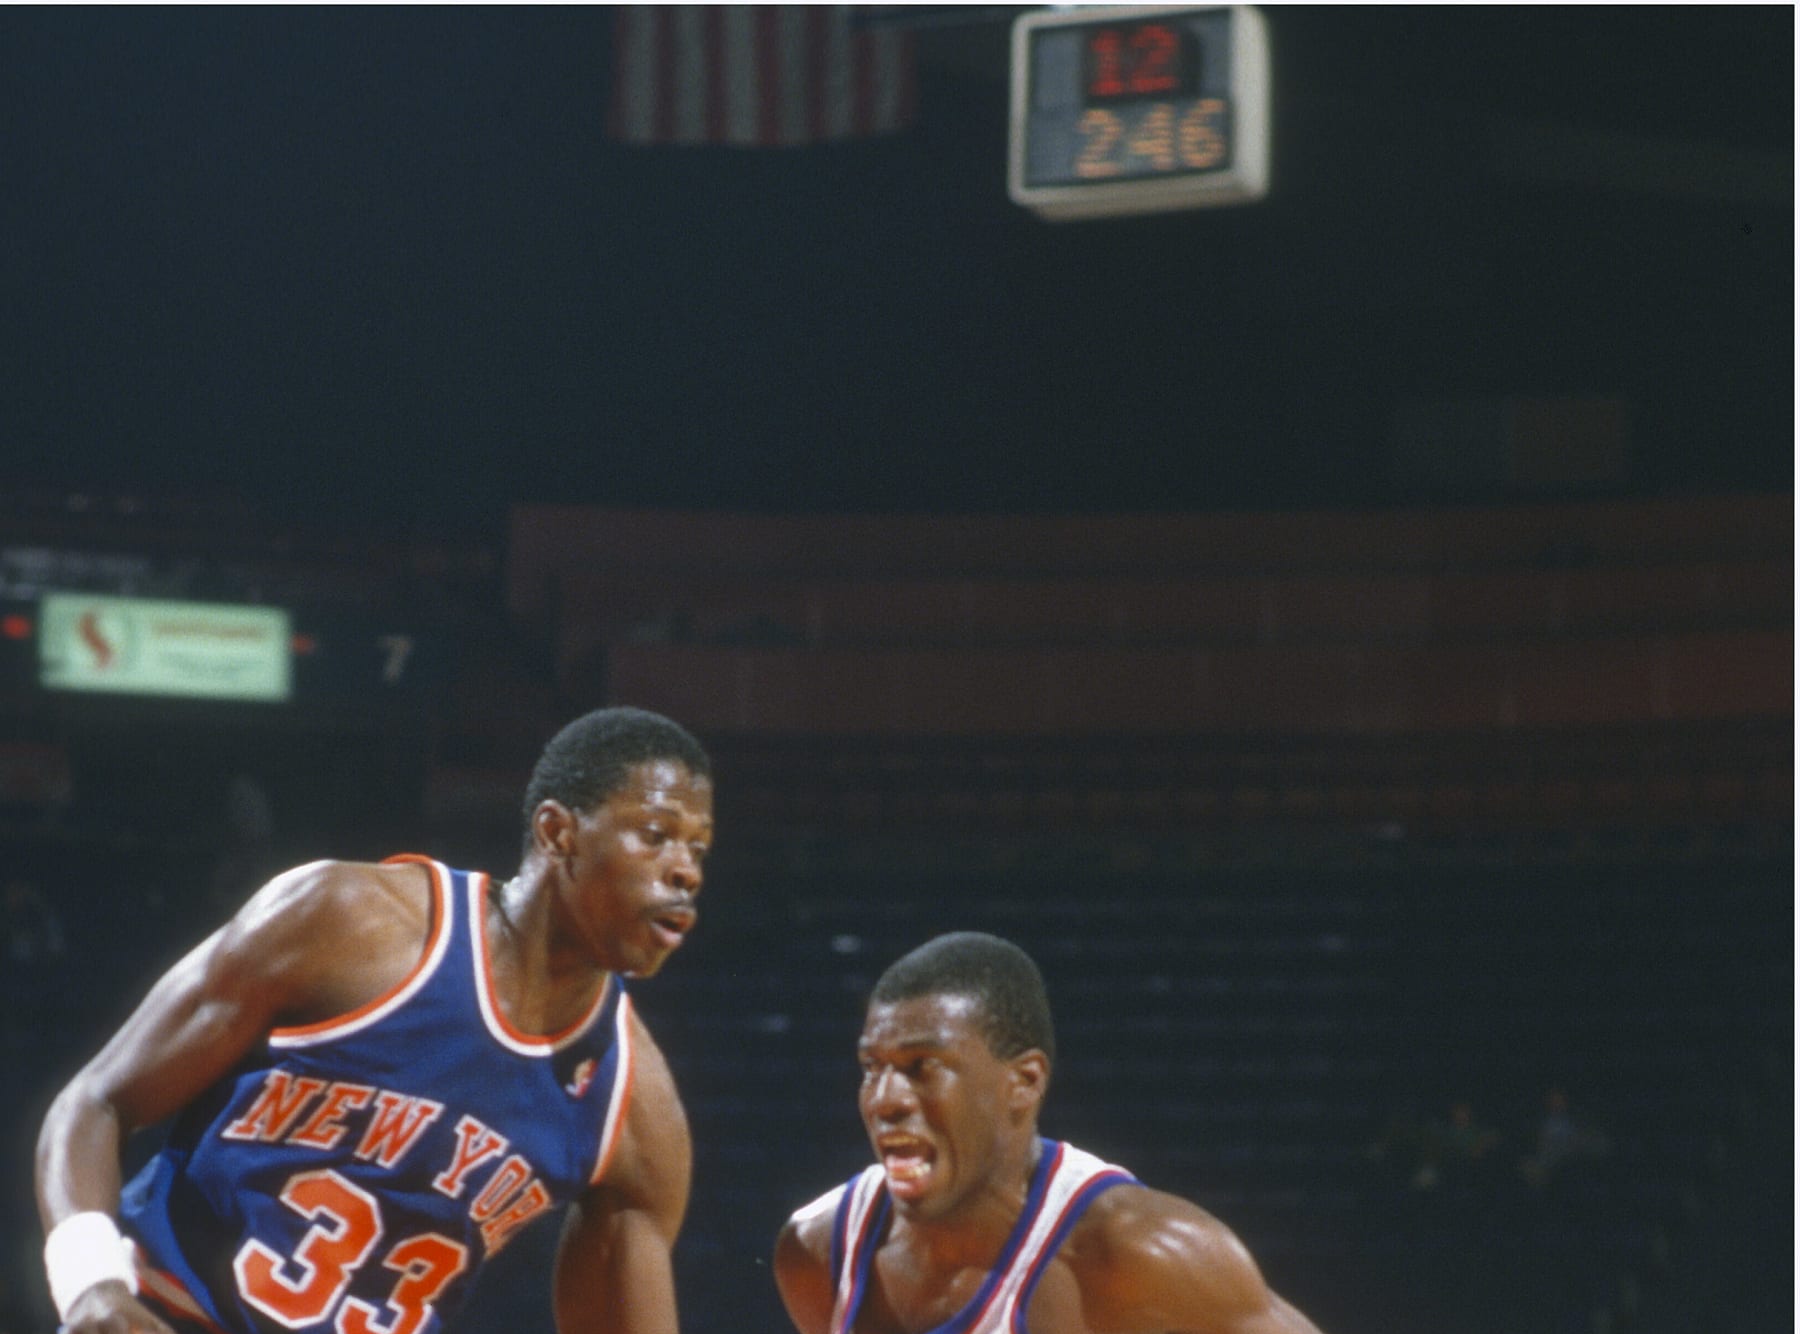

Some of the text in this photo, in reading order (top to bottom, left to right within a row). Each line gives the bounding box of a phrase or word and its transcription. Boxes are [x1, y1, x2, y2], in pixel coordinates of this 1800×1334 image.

[1090, 25, 1180, 96] 12
[221, 1069, 553, 1259] NEW YOR
